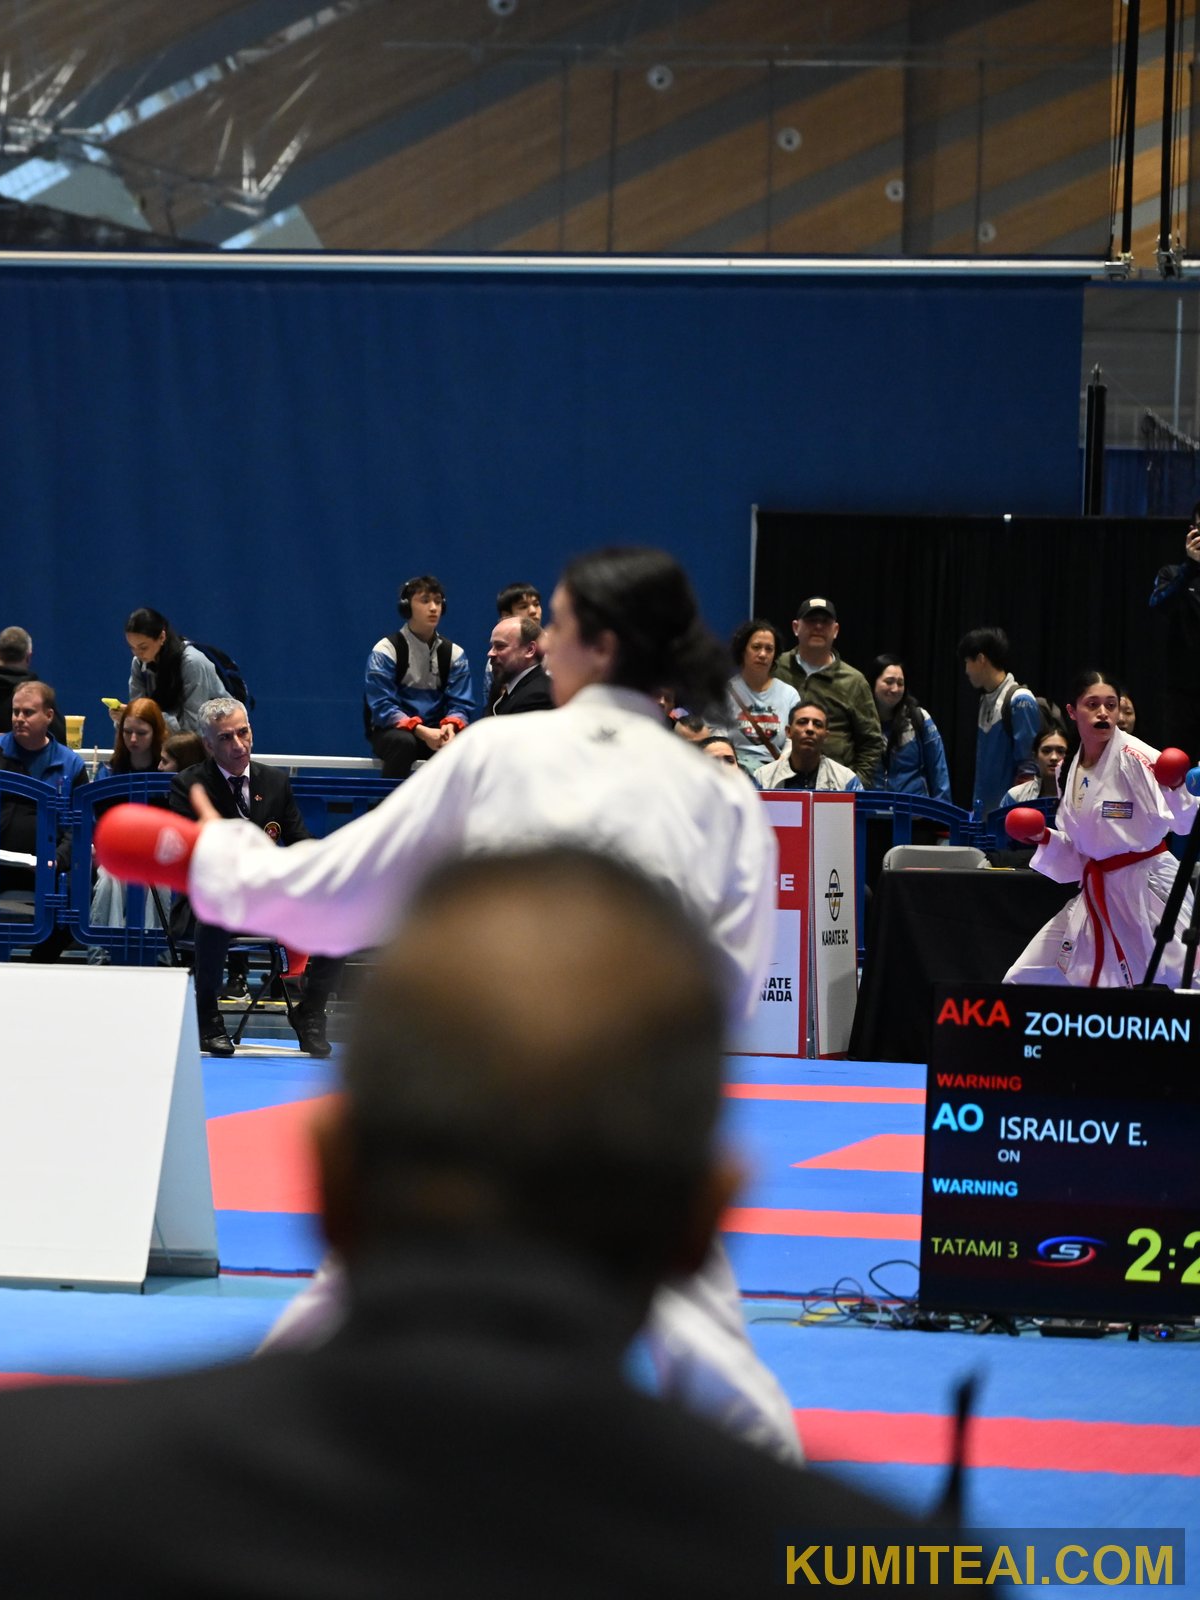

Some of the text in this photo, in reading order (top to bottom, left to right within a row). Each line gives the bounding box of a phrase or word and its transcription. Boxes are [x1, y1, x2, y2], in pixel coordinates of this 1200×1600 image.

[822, 929, 849, 946] KARATE BC
[936, 998, 1191, 1042] AKA ZOHOURIAN
[1023, 1045, 1042, 1059] BC
[936, 1073, 1022, 1091] WARNING
[932, 1103, 1148, 1147] AO ISRAILOV E.
[997, 1149, 1021, 1163] ON
[932, 1178, 1018, 1197] WARNING
[931, 1237, 1002, 1258] TATAMI
[1007, 1241, 1019, 1259] 3
